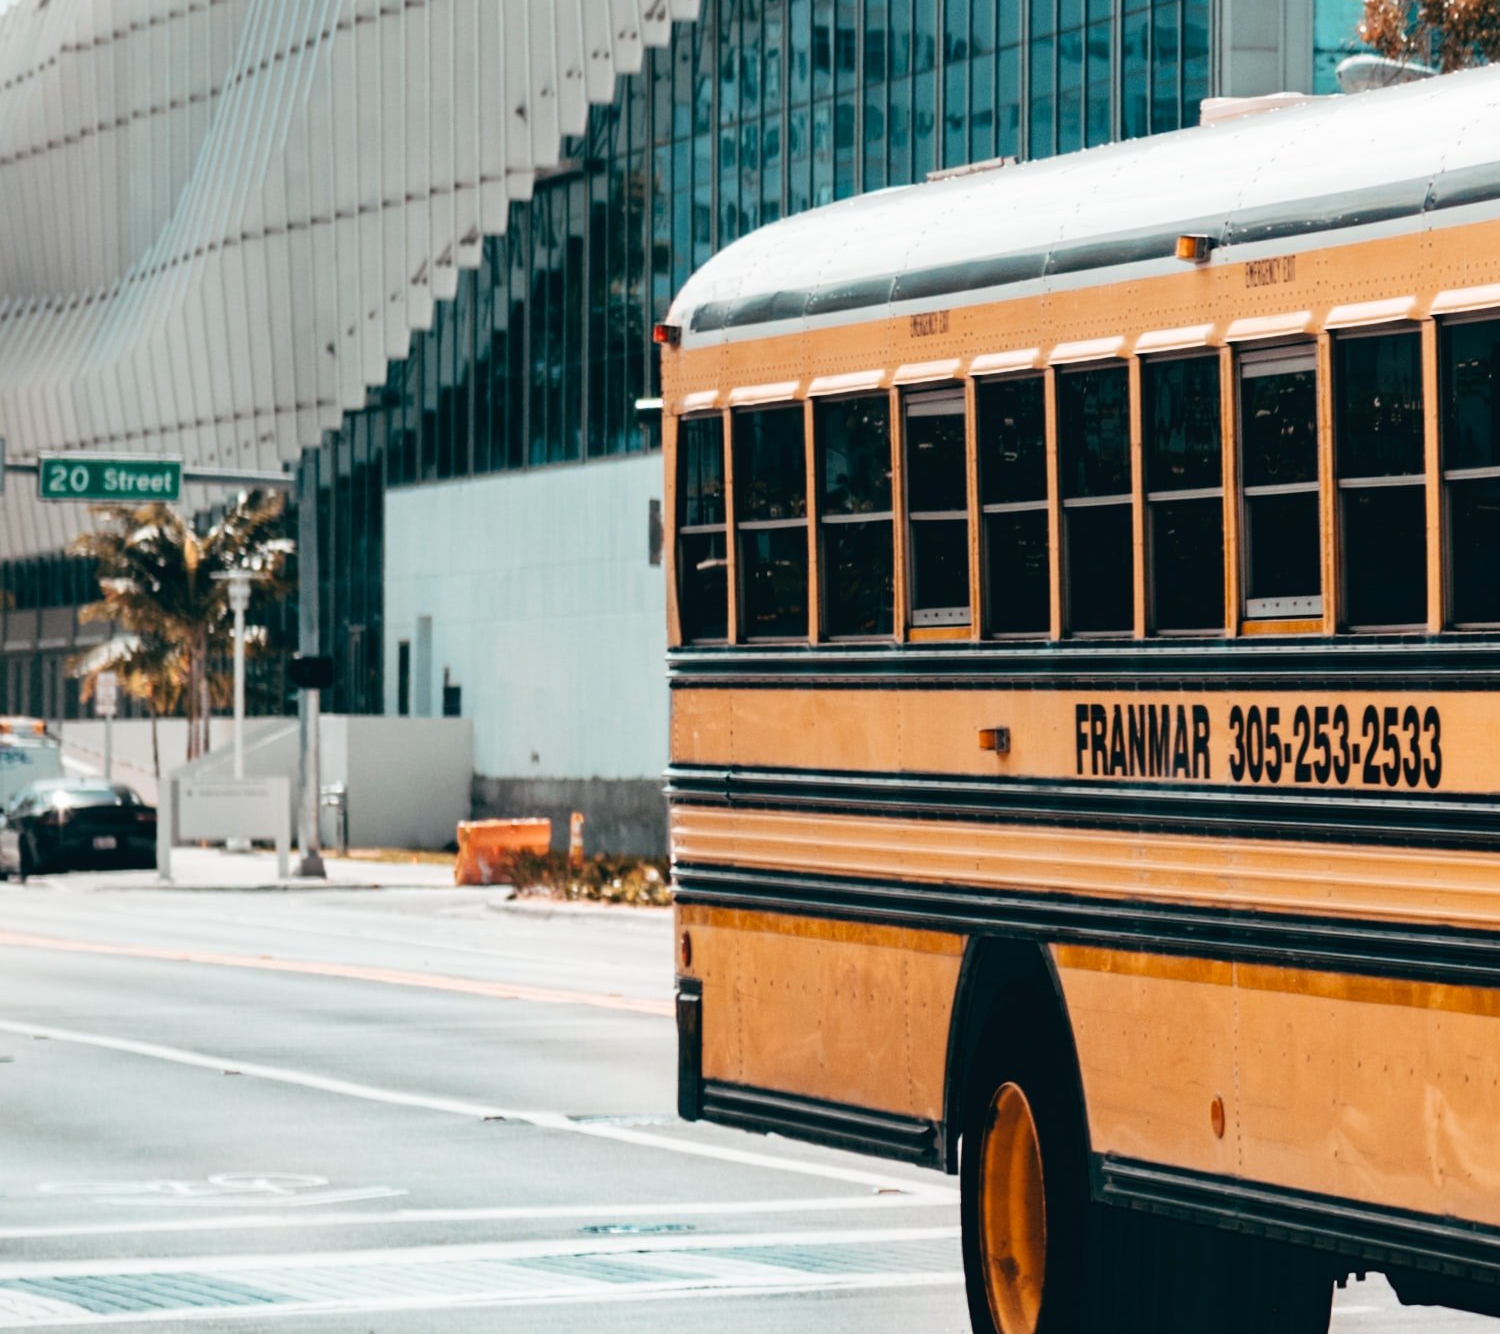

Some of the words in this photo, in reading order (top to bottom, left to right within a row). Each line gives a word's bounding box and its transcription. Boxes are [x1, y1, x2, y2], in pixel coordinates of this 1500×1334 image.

[49, 465, 90, 493] 20
[103, 468, 172, 493] Street
[1075, 703, 1211, 780] FRANMAR
[1228, 703, 1443, 789] 305-253-2533
